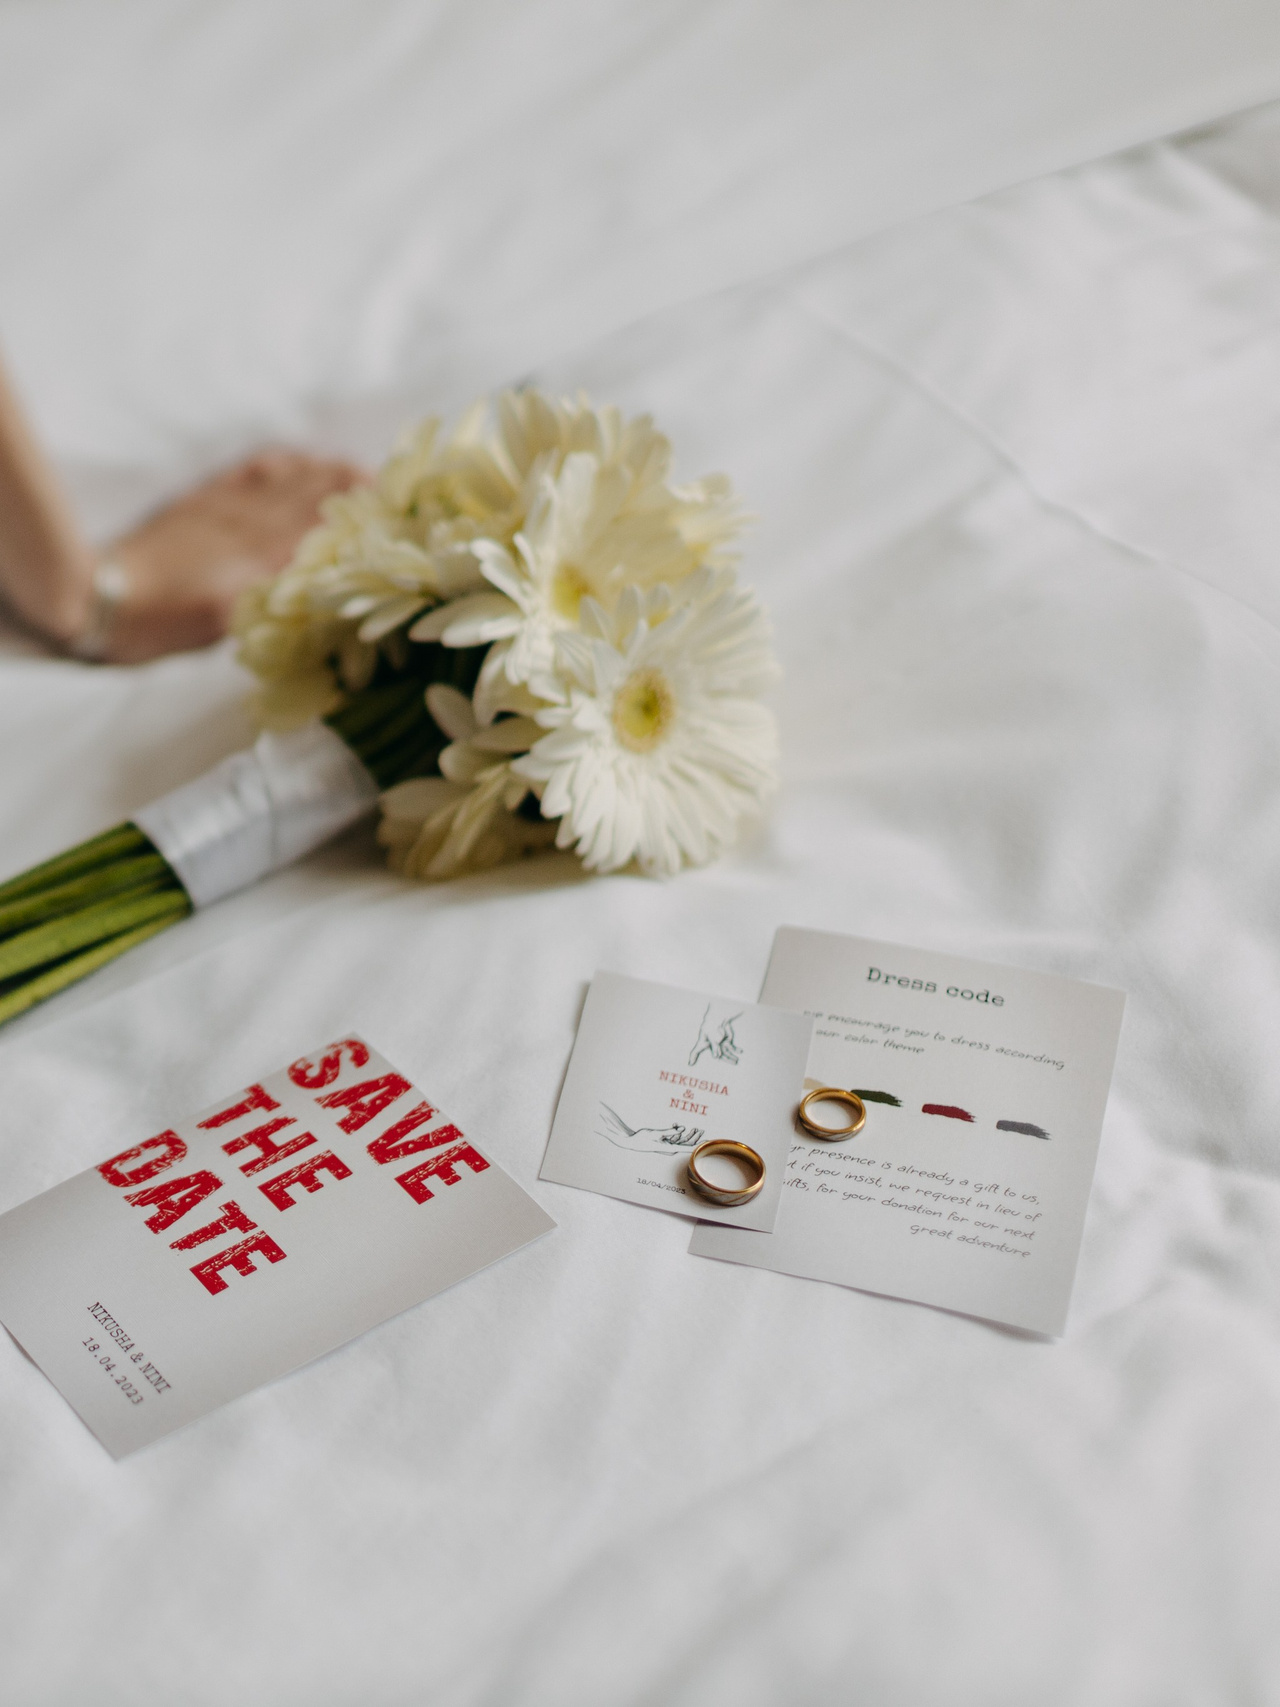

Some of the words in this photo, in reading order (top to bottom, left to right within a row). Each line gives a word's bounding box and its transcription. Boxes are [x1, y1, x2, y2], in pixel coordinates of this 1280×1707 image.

[867, 966, 937, 993] Dress
[946, 984, 1005, 1007] code
[828, 1012, 901, 1034] encourage
[904, 1028, 930, 1039] you
[933, 1031, 946, 1042] to
[950, 1035, 990, 1051] dress
[995, 1045, 1066, 1071] according
[844, 1032, 879, 1046] color
[883, 1039, 925, 1054] theme
[659, 1070, 729, 1096] NIKUSHA
[669, 1098, 709, 1116] NINI
[682, 1089, 694, 1100] &
[195, 1083, 353, 1212] THE
[287, 1038, 491, 1205] SAVE
[637, 1177, 686, 1195] 18/04/2023
[801, 1163, 815, 1172] if
[814, 1167, 841, 1177] you
[889, 1182, 910, 1192] we
[915, 1189, 972, 1207] request
[976, 1201, 990, 1210] in
[994, 1204, 1021, 1217] lieu
[1025, 1212, 1043, 1222] of
[808, 1148, 876, 1166] presence
[881, 1161, 892, 1170] is
[897, 1165, 955, 1186] already
[973, 1183, 1000, 1193] gift
[1004, 1187, 1017, 1198] to
[94, 1129, 288, 1296] DATE
[816, 1183, 838, 1193] for
[842, 1191, 876, 1201] your
[881, 1197, 942, 1218] donation
[946, 1211, 969, 1222] for
[974, 1219, 999, 1230] our
[1004, 1226, 1036, 1241] next
[910, 1224, 953, 1240] great
[957, 1234, 1032, 1257] adventure
[82, 1337, 144, 1405] 18.04.2023
[87, 1301, 135, 1352] NIKUSHA
[130, 1352, 144, 1363] &
[139, 1362, 171, 1395] NINI
